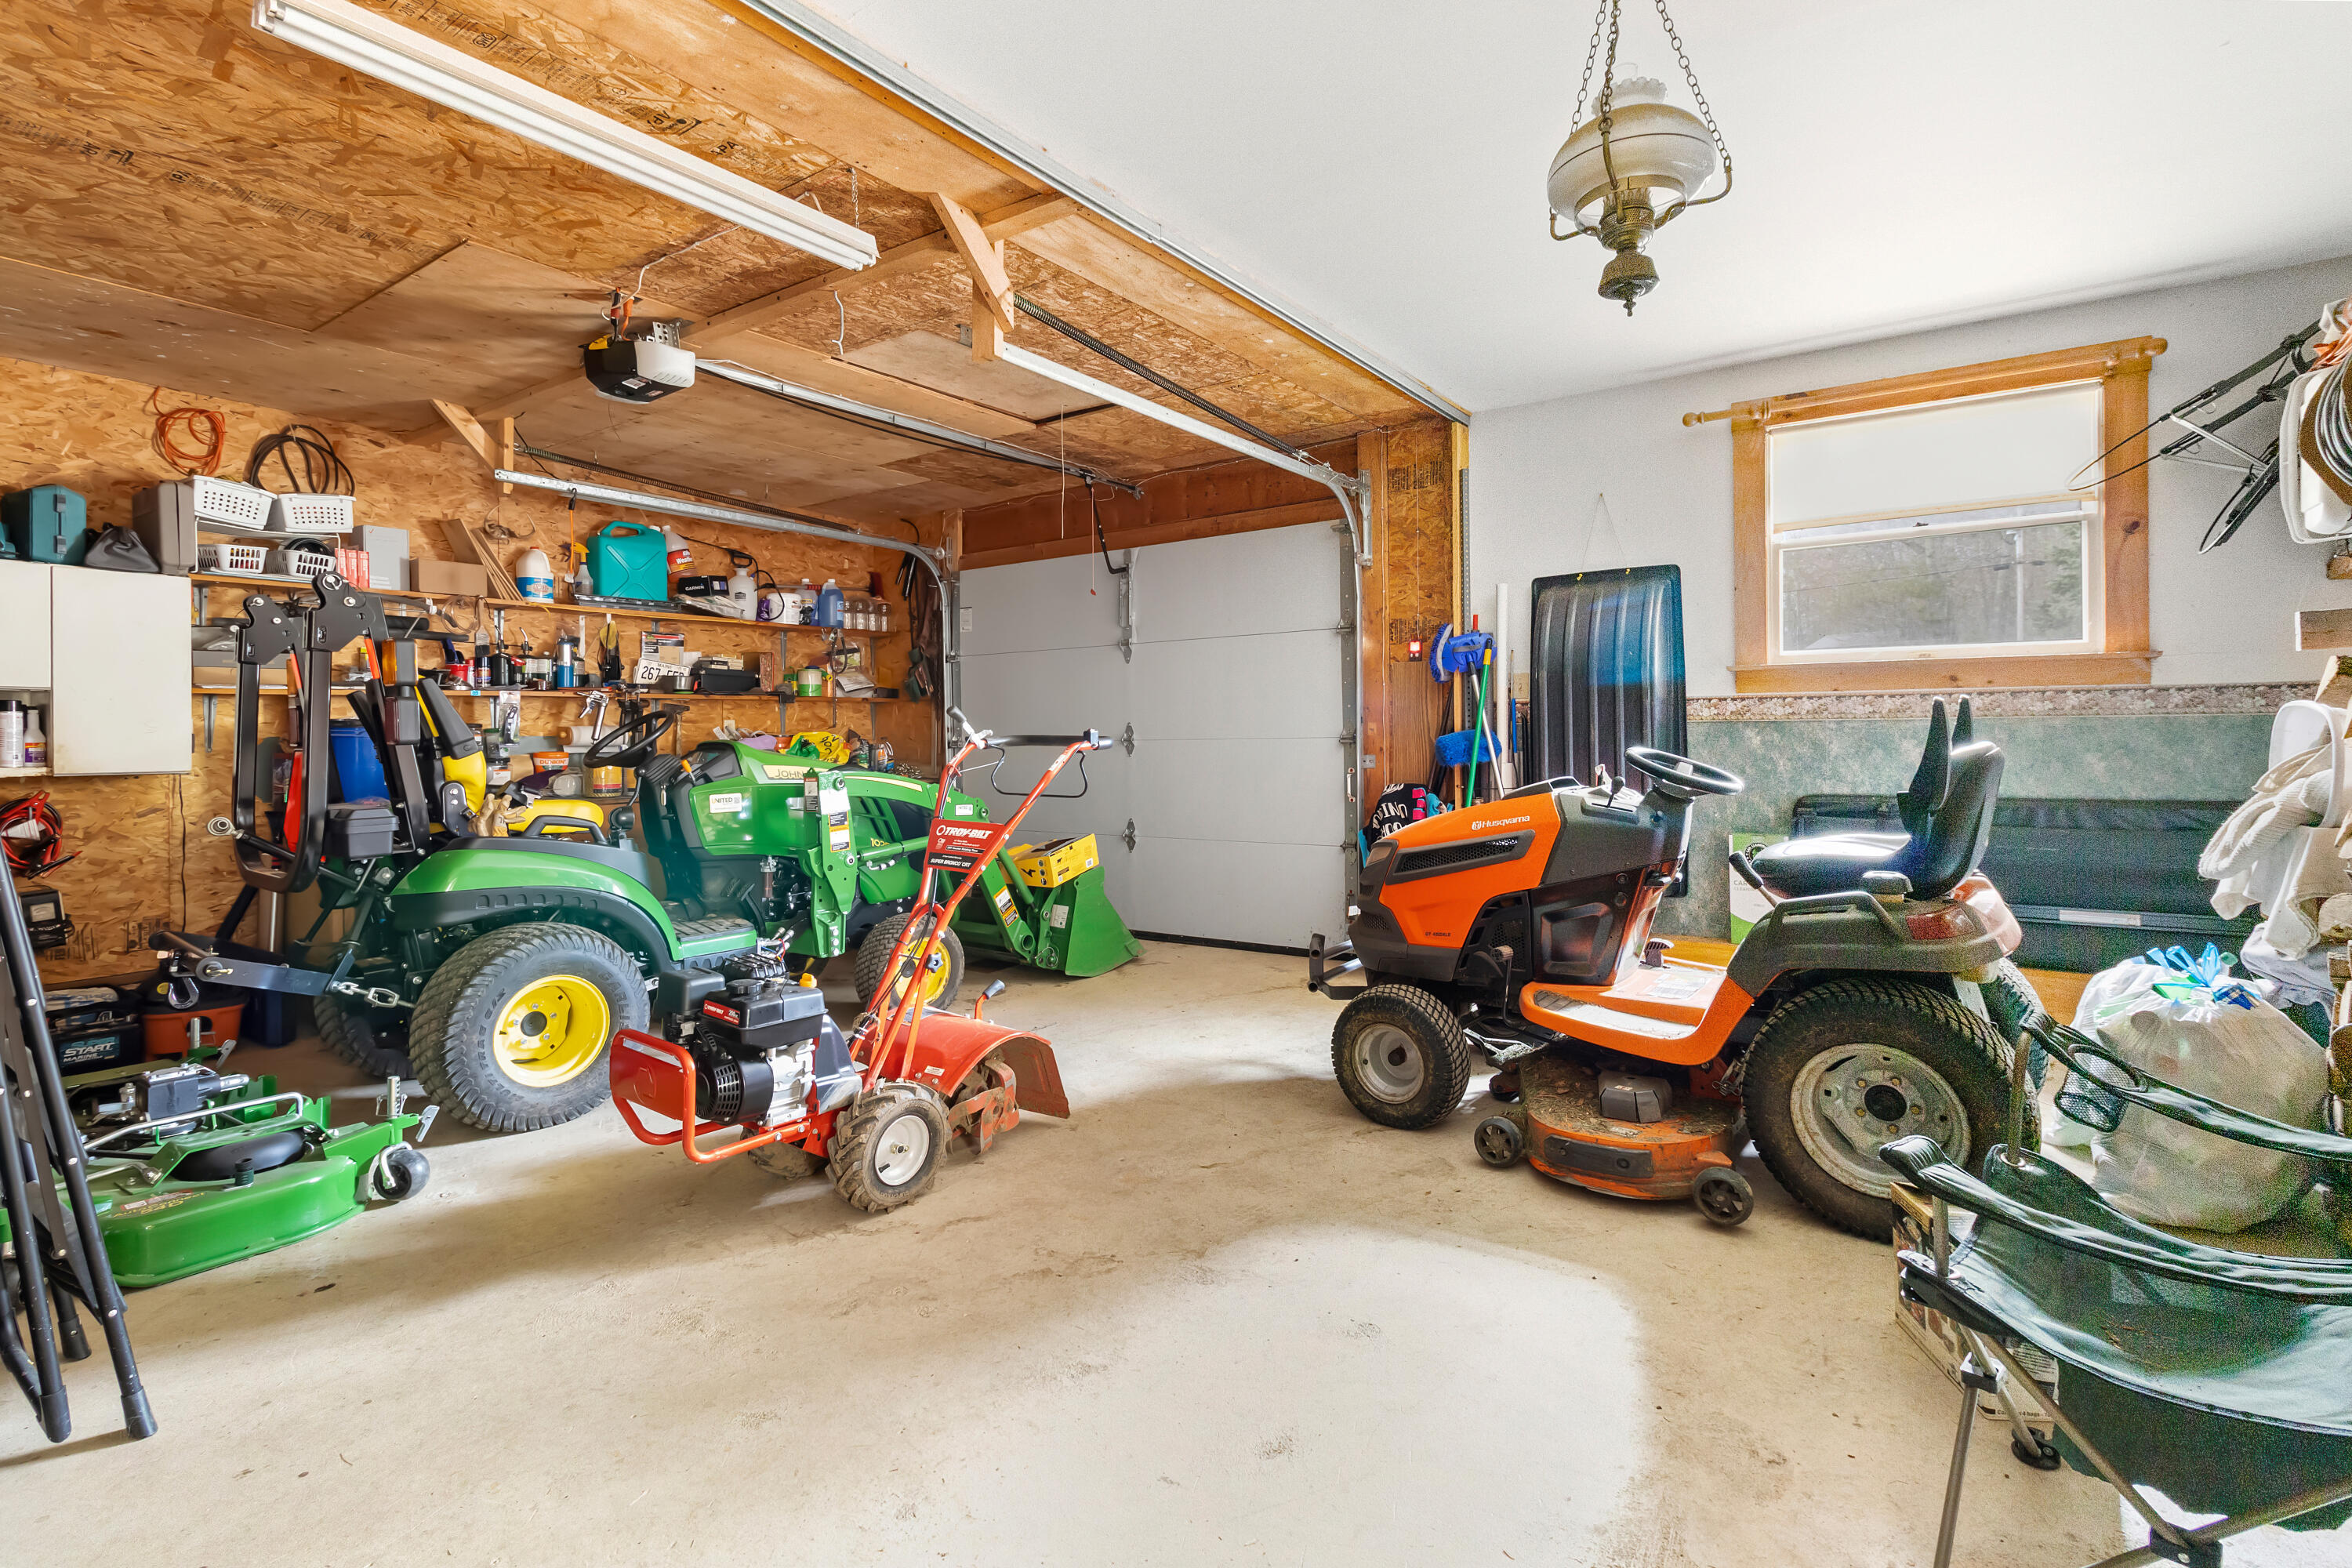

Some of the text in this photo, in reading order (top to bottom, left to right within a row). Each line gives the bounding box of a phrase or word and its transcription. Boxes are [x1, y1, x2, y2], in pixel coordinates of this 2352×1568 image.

[641, 666, 661, 681] 267
[775, 768, 804, 778] JOHN
[1482, 815, 1530, 828] Husqvarna
[944, 826, 993, 840] TROY-BILT
[64, 1042, 116, 1058] START
[64, 1053, 99, 1062] MARINE
